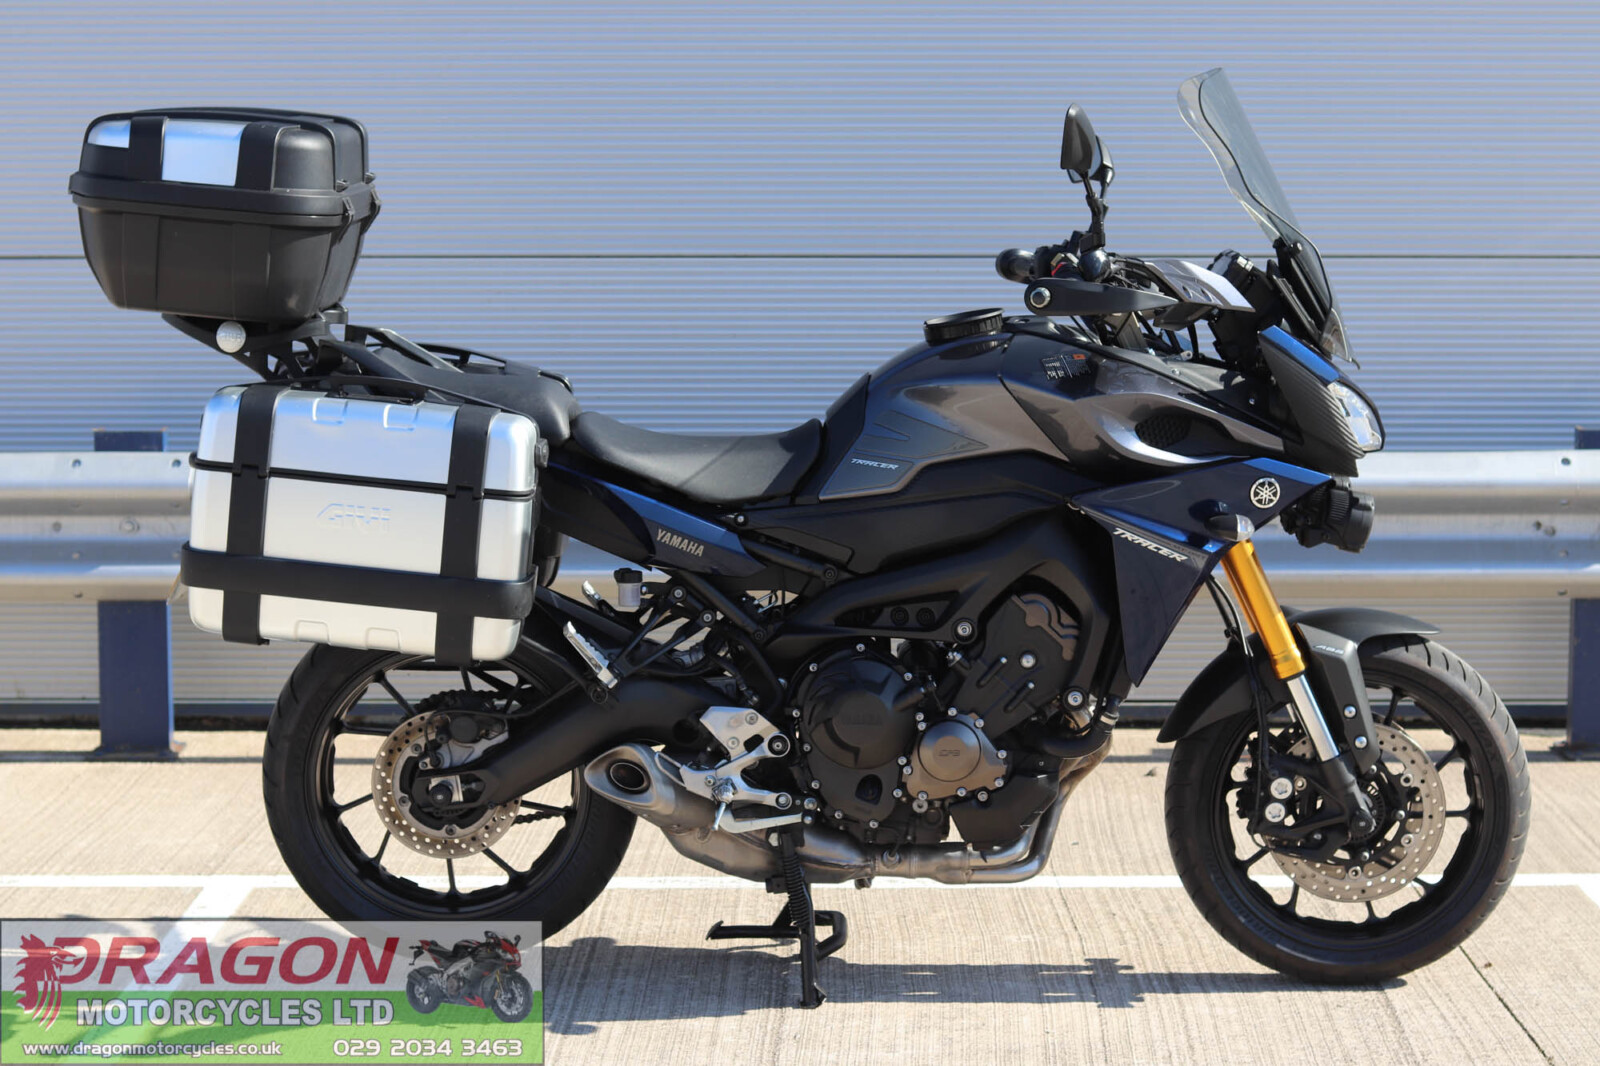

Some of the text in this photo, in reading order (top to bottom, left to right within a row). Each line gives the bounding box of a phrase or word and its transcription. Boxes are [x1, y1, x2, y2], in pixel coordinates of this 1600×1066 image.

[851, 458, 899, 470] TRACER
[656, 528, 705, 557] YAMAHA
[1113, 527, 1188, 562] TRACER
